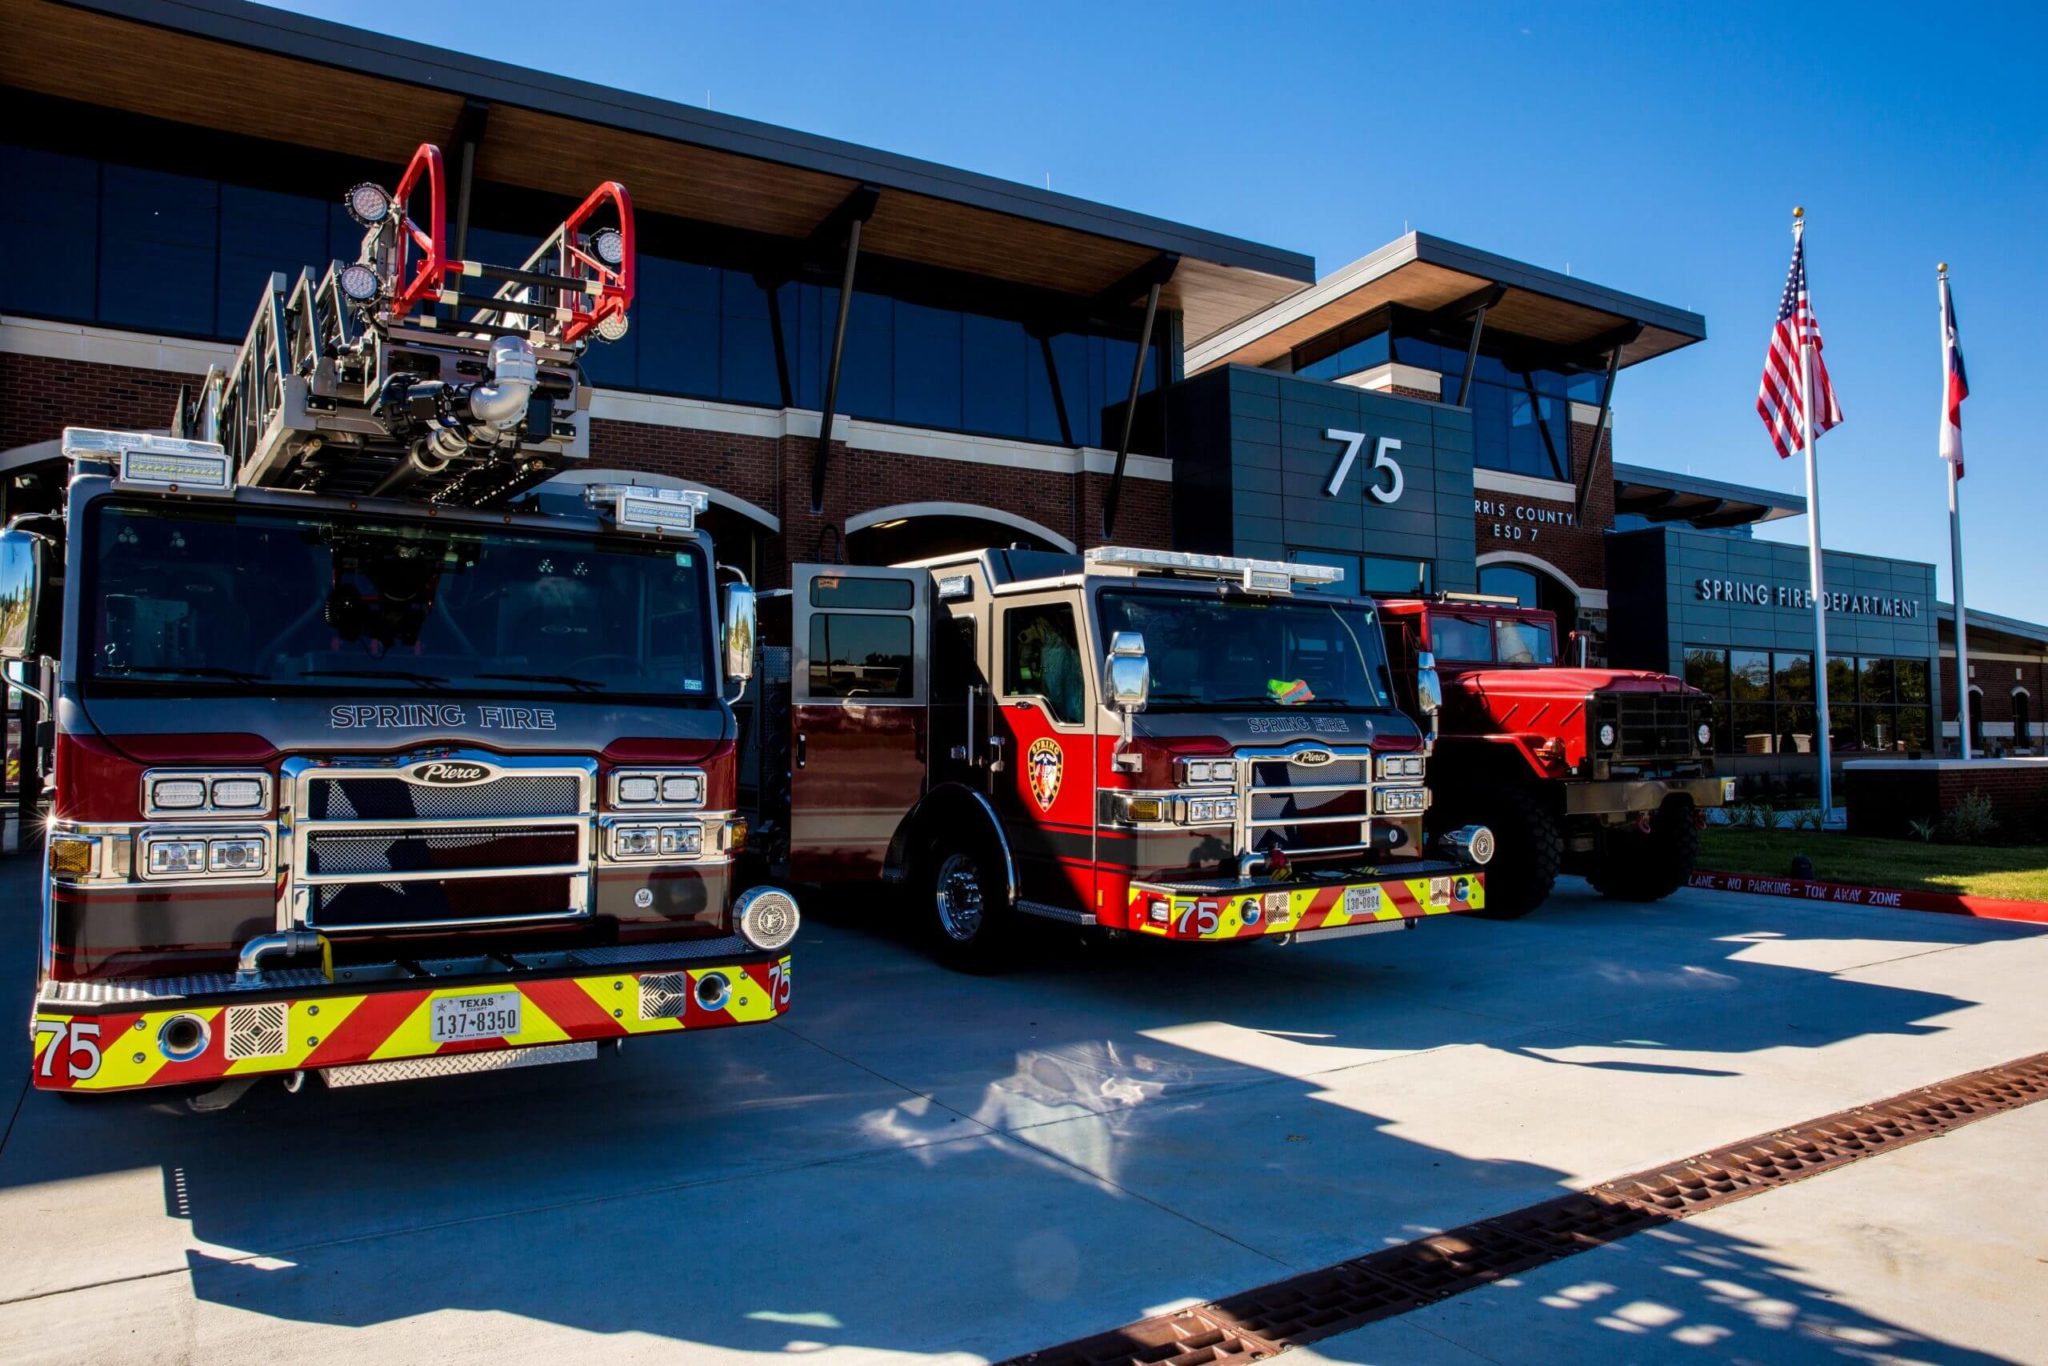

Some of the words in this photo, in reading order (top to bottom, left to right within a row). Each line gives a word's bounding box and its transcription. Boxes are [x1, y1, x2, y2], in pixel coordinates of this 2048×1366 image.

[1327, 428, 1404, 504] 75
[1516, 506, 1573, 526] COUNTY
[1494, 523, 1521, 539] ESD
[1531, 528, 1538, 541] 7
[1702, 578, 1769, 605] SPRING
[1778, 586, 1811, 609] FIRE
[1823, 591, 1919, 618] DEPARTMENT
[330, 704, 466, 729] SPRING
[478, 705, 557, 730] FIRE
[1247, 716, 1310, 733] SPRING
[1311, 717, 1350, 733] FIRE
[1301, 752, 1327, 764] Pierce
[423, 763, 482, 781] Pierce
[1688, 875, 1716, 889] LANE
[1727, 878, 1742, 890] NO
[1747, 879, 1791, 895] PARKING
[1804, 884, 1827, 899] TOW
[1833, 887, 1862, 902] AWAY
[1868, 891, 1903, 907] ZONE
[1174, 901, 1219, 934] 75
[768, 960, 791, 1010] 75
[460, 997, 494, 1008] TEXAS
[36, 1020, 102, 1080] 75
